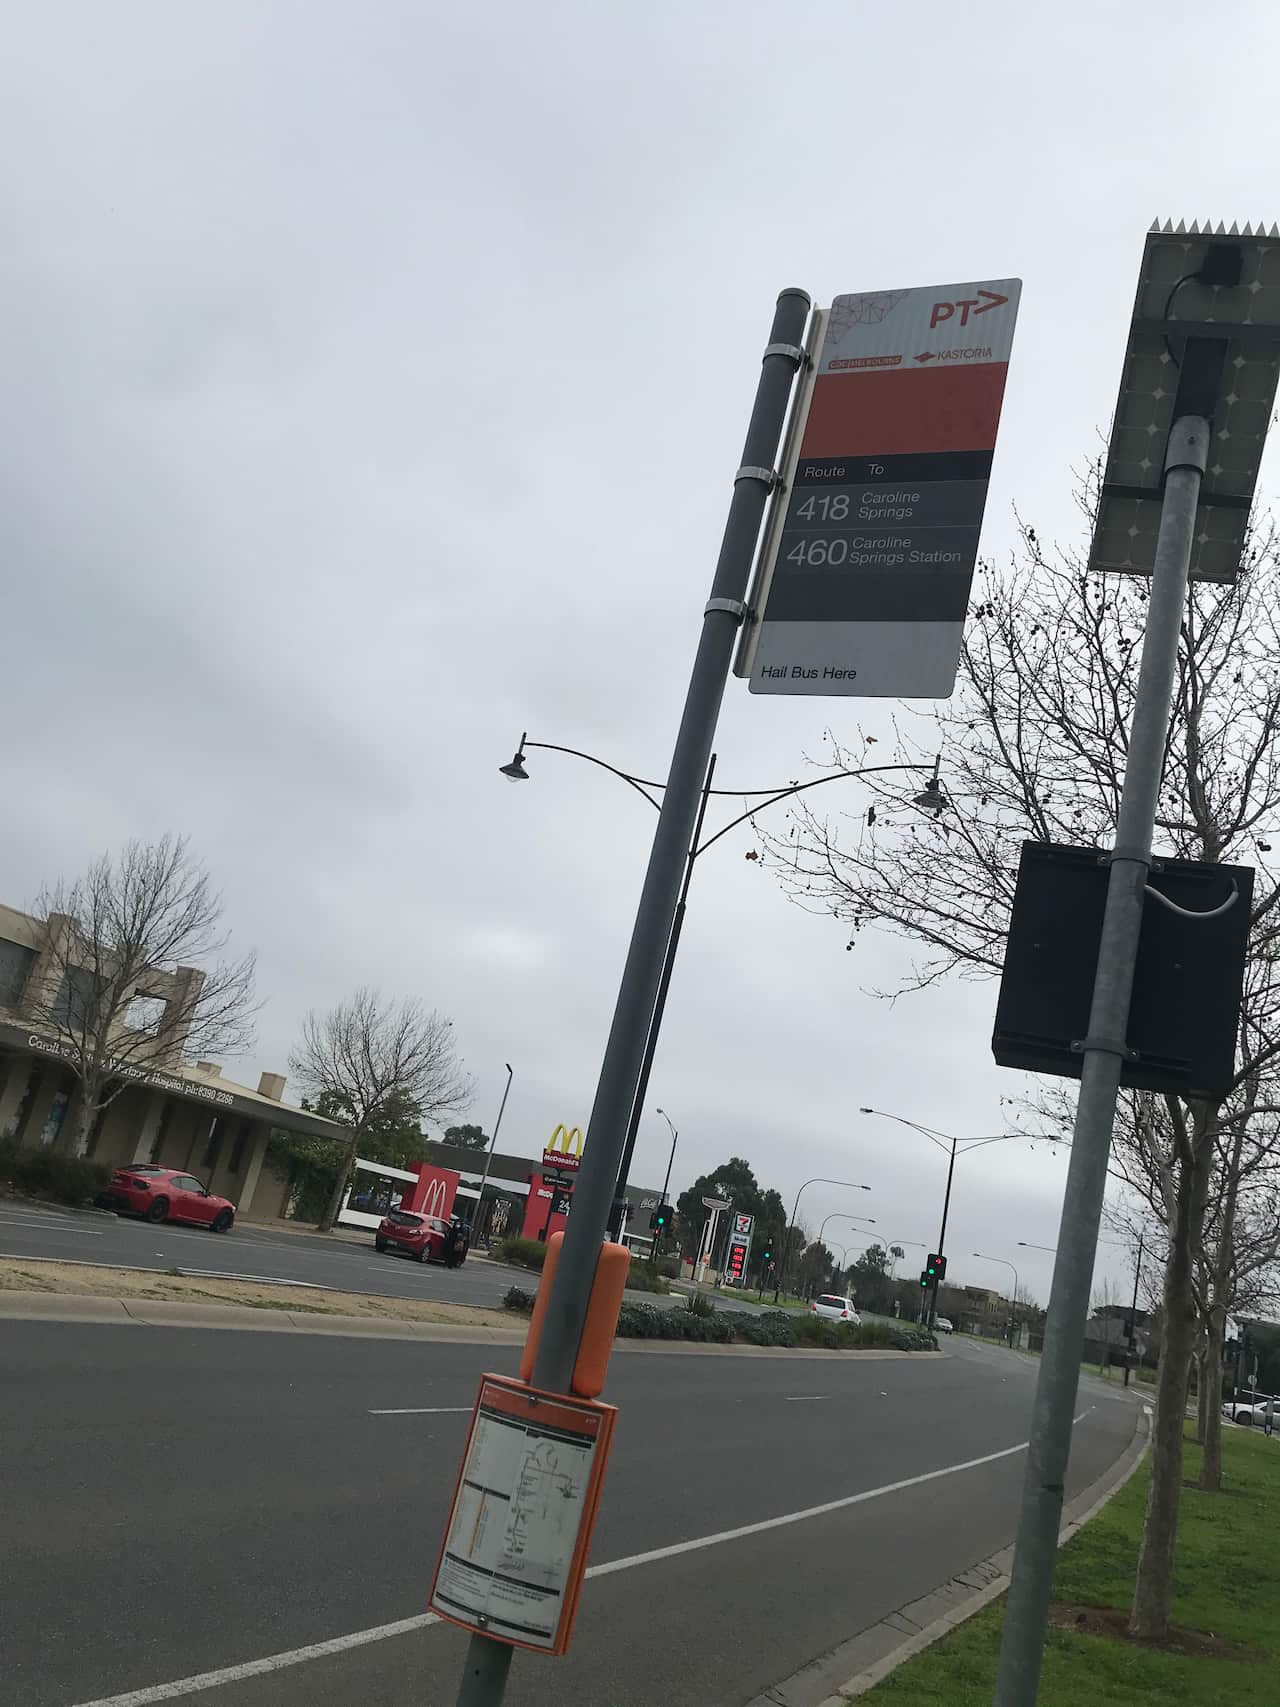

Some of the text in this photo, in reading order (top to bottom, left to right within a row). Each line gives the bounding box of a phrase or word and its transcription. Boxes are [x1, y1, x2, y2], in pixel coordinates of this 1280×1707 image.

[937, 347, 993, 361] KASTORIA
[804, 463, 885, 478] Route To
[796, 491, 921, 521] 418 Caroline
[858, 506, 914, 520] Springs
[786, 536, 912, 566] 460 Caroline
[849, 550, 962, 566] Springs Station
[760, 665, 858, 680] Hail Bus Here
